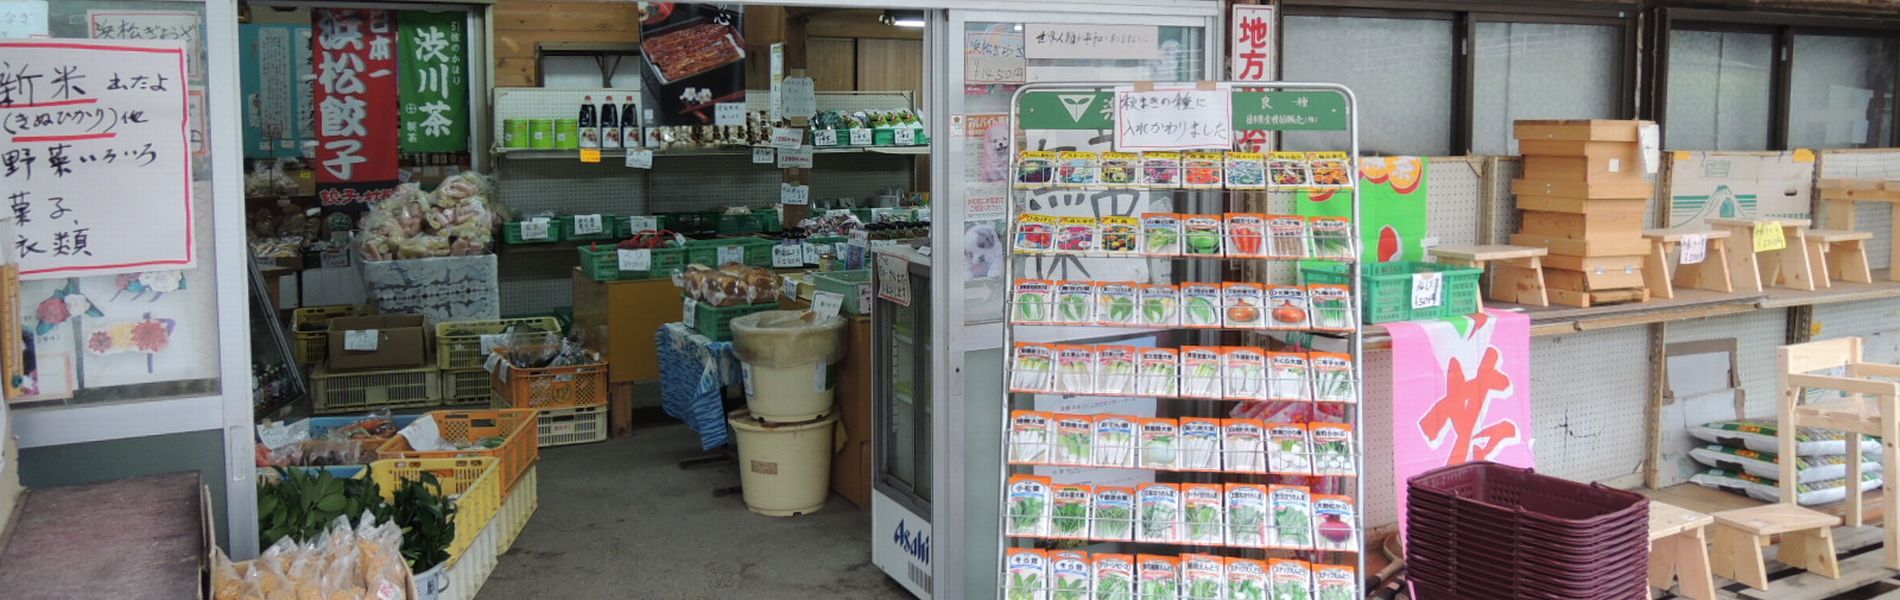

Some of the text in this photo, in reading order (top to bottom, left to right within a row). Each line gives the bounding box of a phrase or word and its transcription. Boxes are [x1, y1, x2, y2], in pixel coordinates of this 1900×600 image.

[0, 61, 169, 107] 新米 出たよ
[318, 9, 369, 181] 浜松餃子
[414, 26, 453, 138] 渋川茶
[1121, 91, 1207, 112] 秋まきの種に
[1123, 119, 1229, 142] 入れかわりました
[1, 143, 158, 180] 野菜いろいろ
[15, 227, 93, 258] 衣類
[894, 518, 930, 566] Asahi
